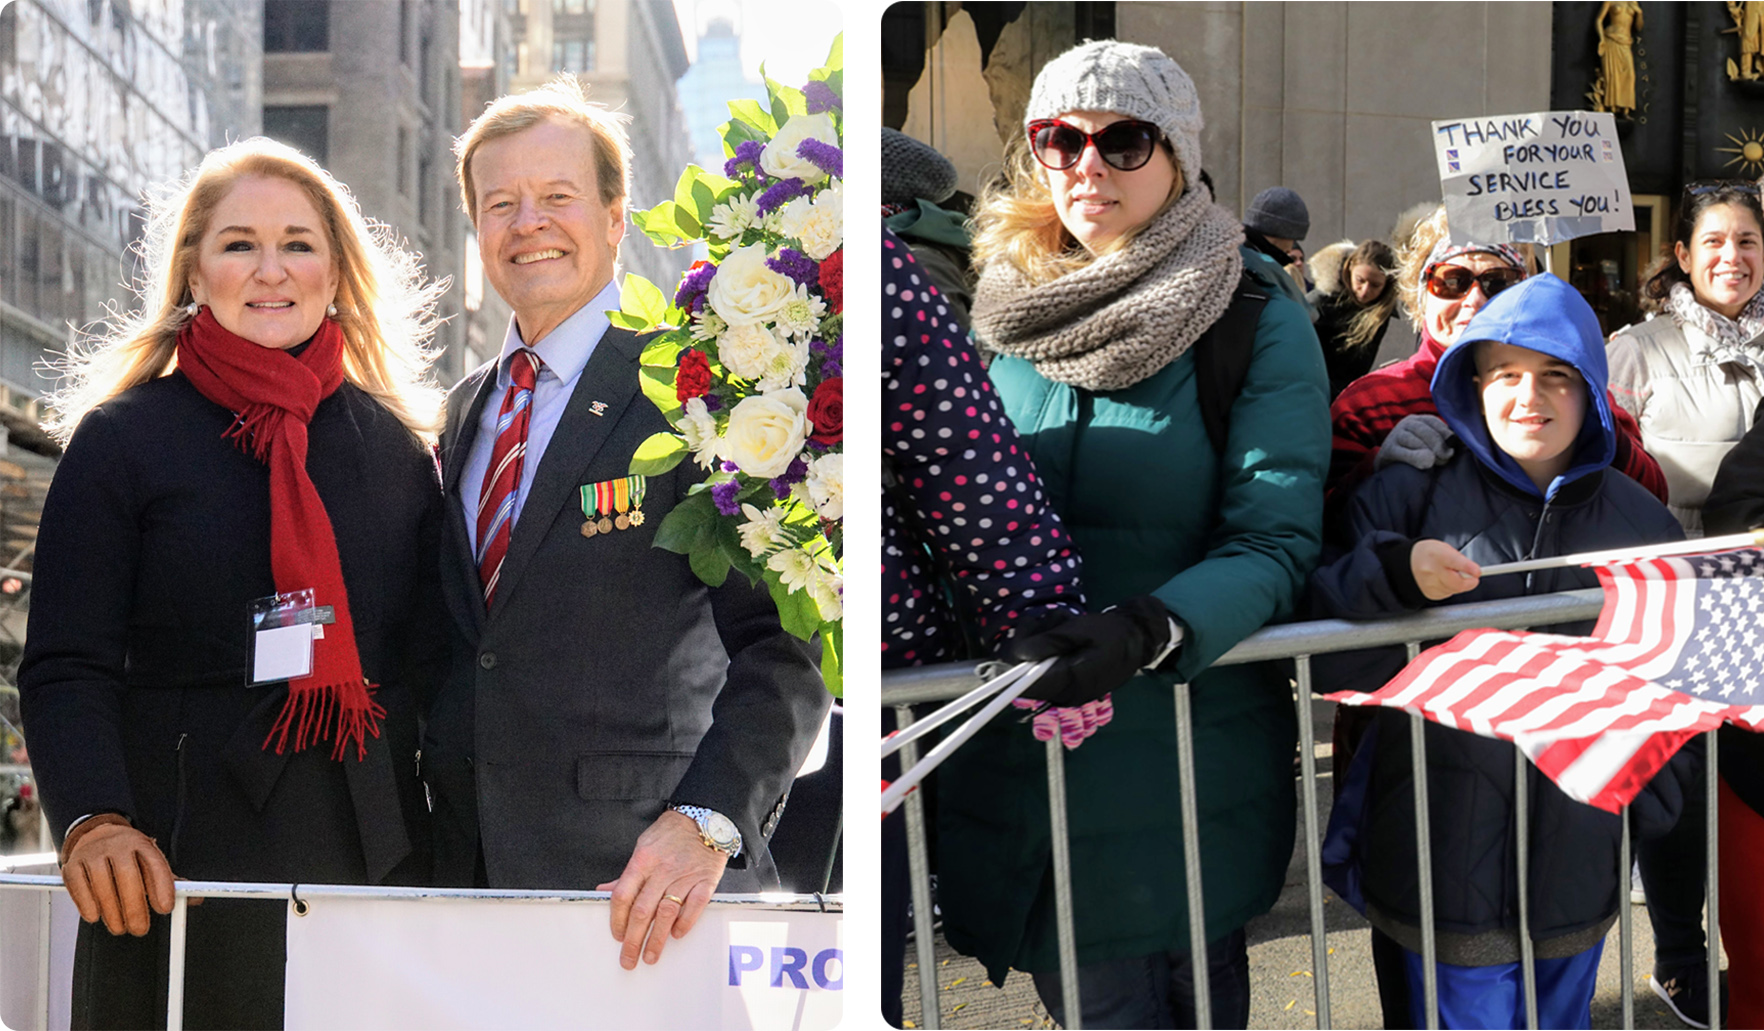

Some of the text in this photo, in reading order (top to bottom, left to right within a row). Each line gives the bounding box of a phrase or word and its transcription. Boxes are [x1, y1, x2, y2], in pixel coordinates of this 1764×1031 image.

[1437, 115, 1601, 147] THANK YOU
[1504, 143, 1597, 165] FOR YOUR
[1466, 170, 1571, 196] SERVICE
[1494, 189, 1620, 222] BLESS YOU!
[728, 945, 843, 991] PRO
